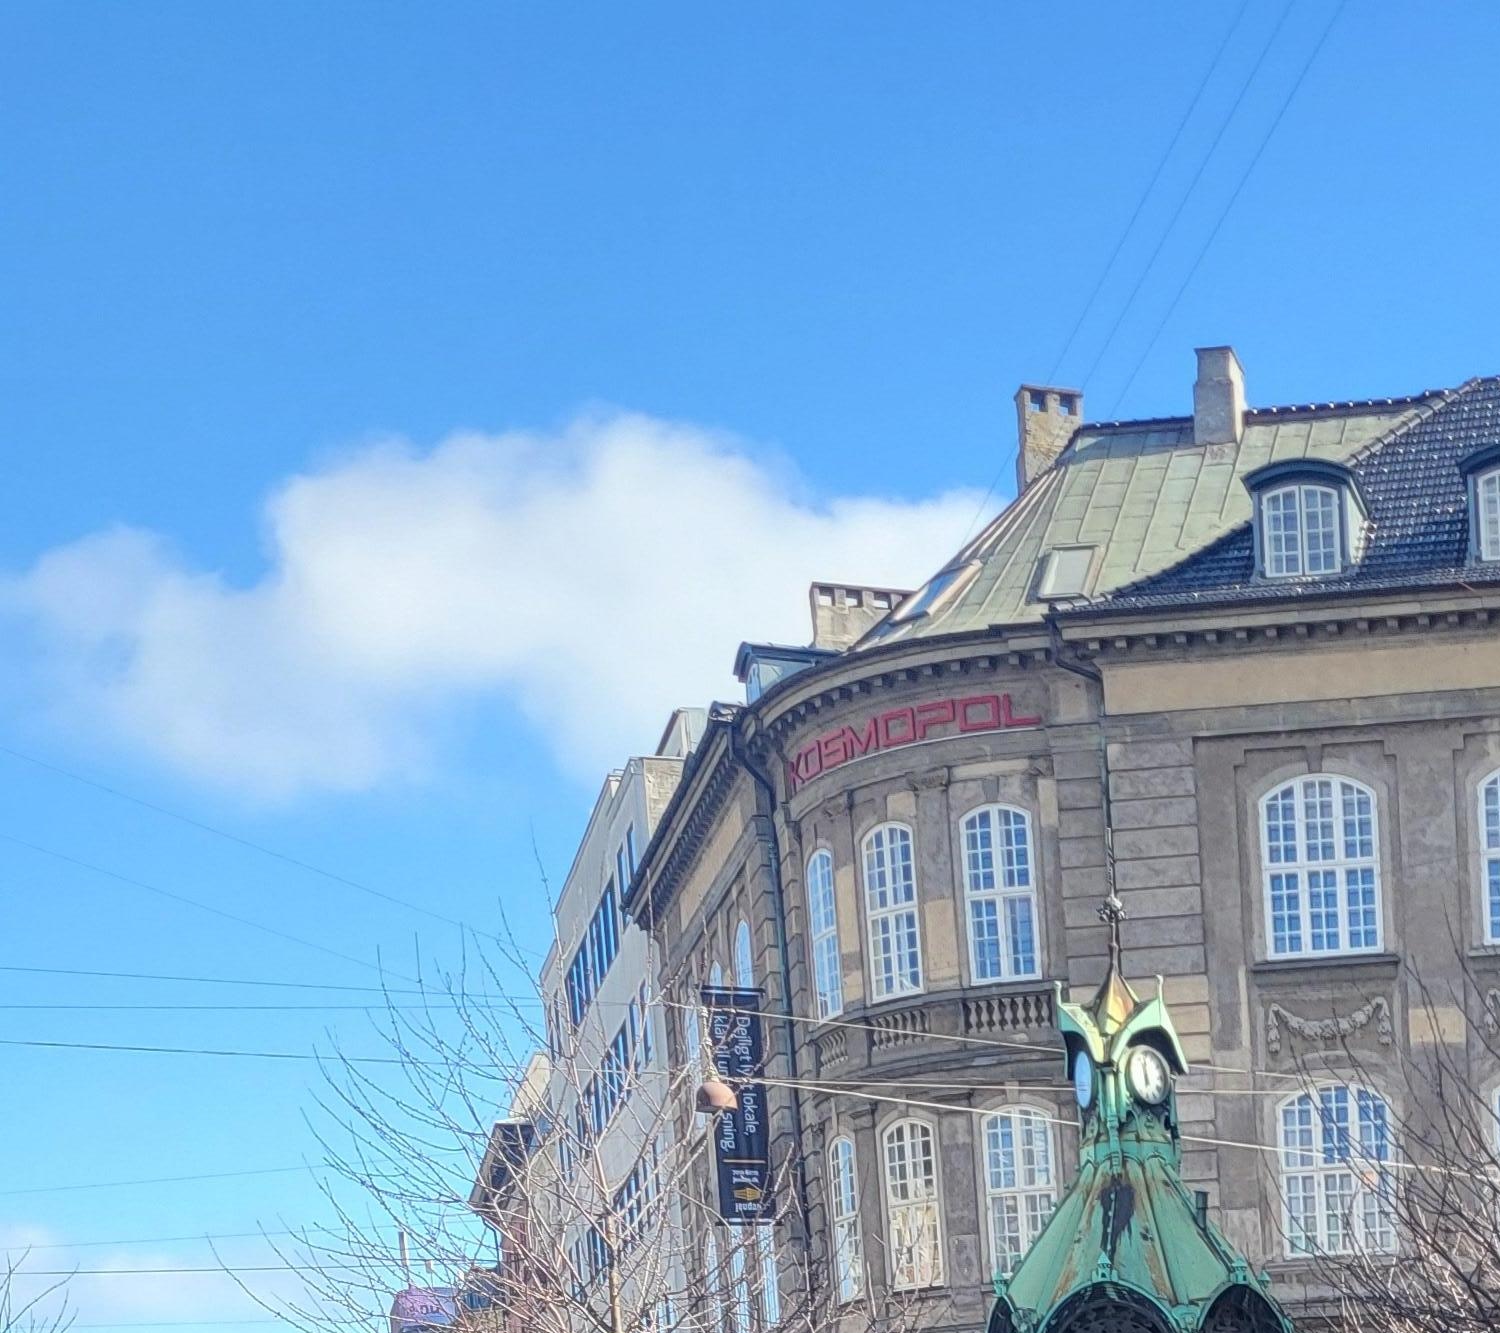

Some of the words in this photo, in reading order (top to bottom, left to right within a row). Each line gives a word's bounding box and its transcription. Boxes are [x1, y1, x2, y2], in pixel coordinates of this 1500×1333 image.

[788, 693, 1042, 792] KOSMOPOL
[737, 1064, 754, 1090] lyt
[743, 1092, 760, 1137] lokale,
